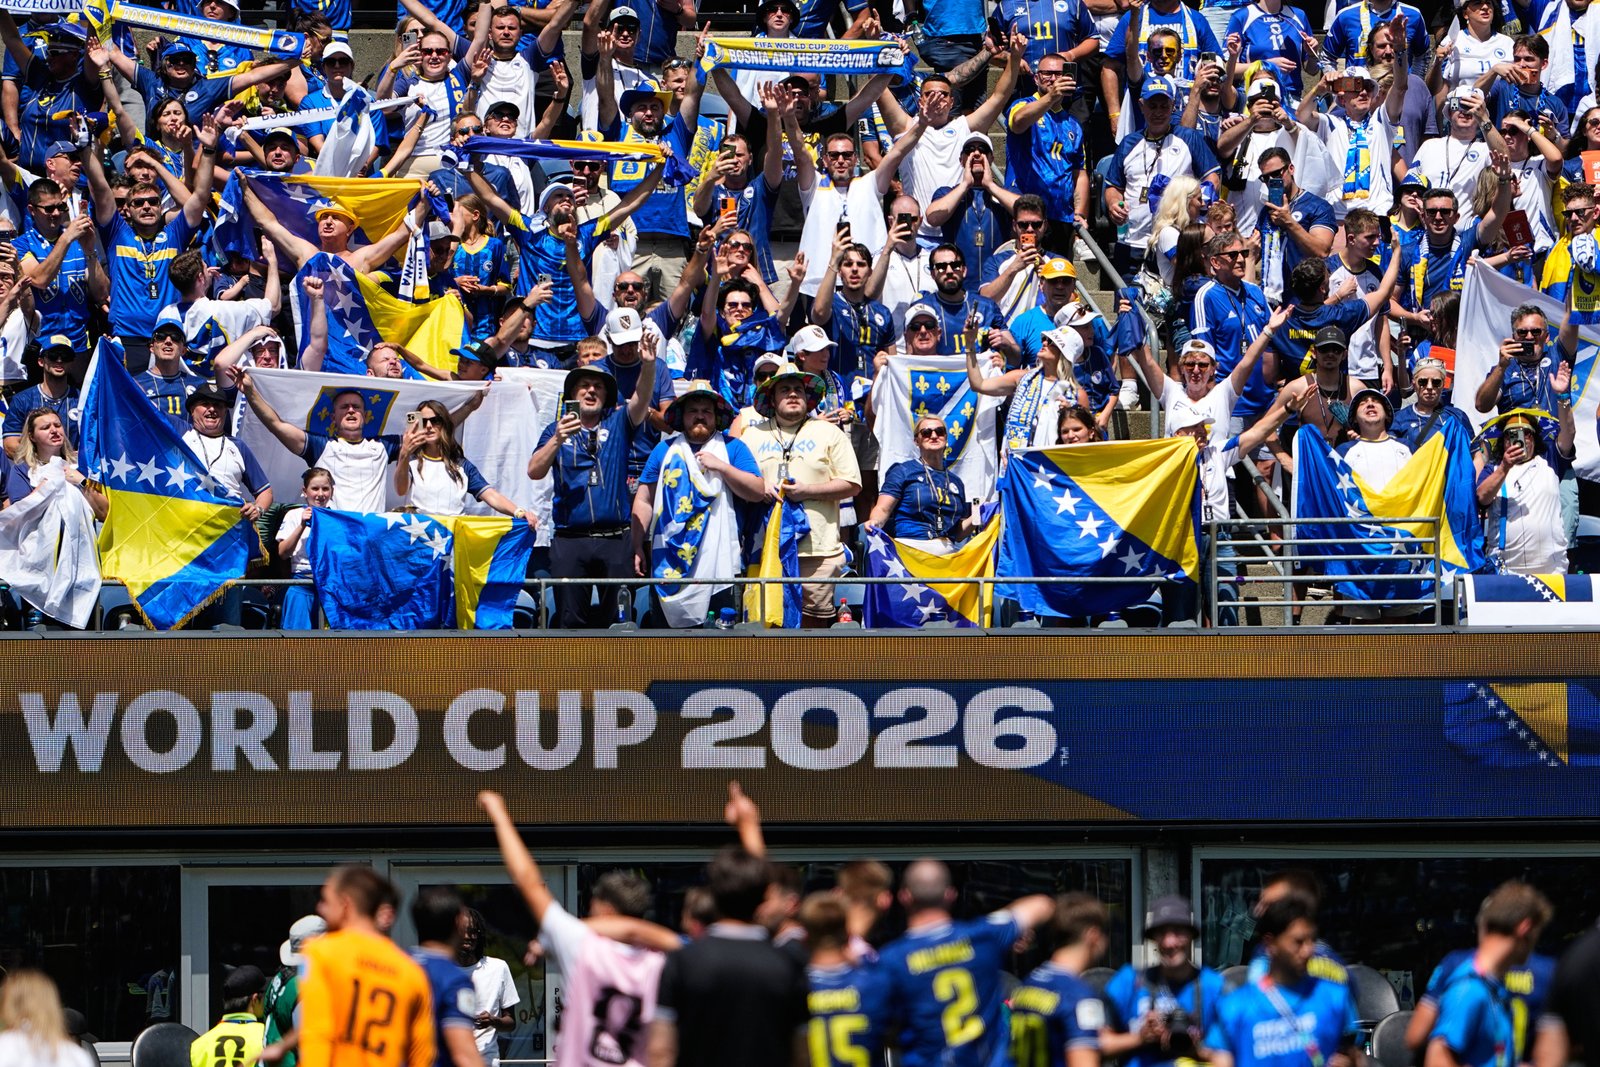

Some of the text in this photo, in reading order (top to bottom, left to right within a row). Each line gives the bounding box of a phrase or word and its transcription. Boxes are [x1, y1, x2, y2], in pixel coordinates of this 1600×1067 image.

[1034, 21, 1053, 40] 11
[754, 41, 773, 49] FIFA
[774, 42, 805, 50] WORLD
[1270, 35, 1286, 50] 11
[728, 49, 770, 66] BOSNIA
[772, 51, 795, 67] AND
[797, 52, 874, 68] HERZEGOVINA
[860, 325, 871, 344] 11
[167, 395, 182, 415] 11
[18, 689, 420, 774] WORLD
[442, 687, 658, 772] CUP
[680, 685, 1058, 770] 2026
[343, 978, 396, 1055] 12
[932, 967, 985, 1047] 2
[807, 1013, 870, 1067] 15
